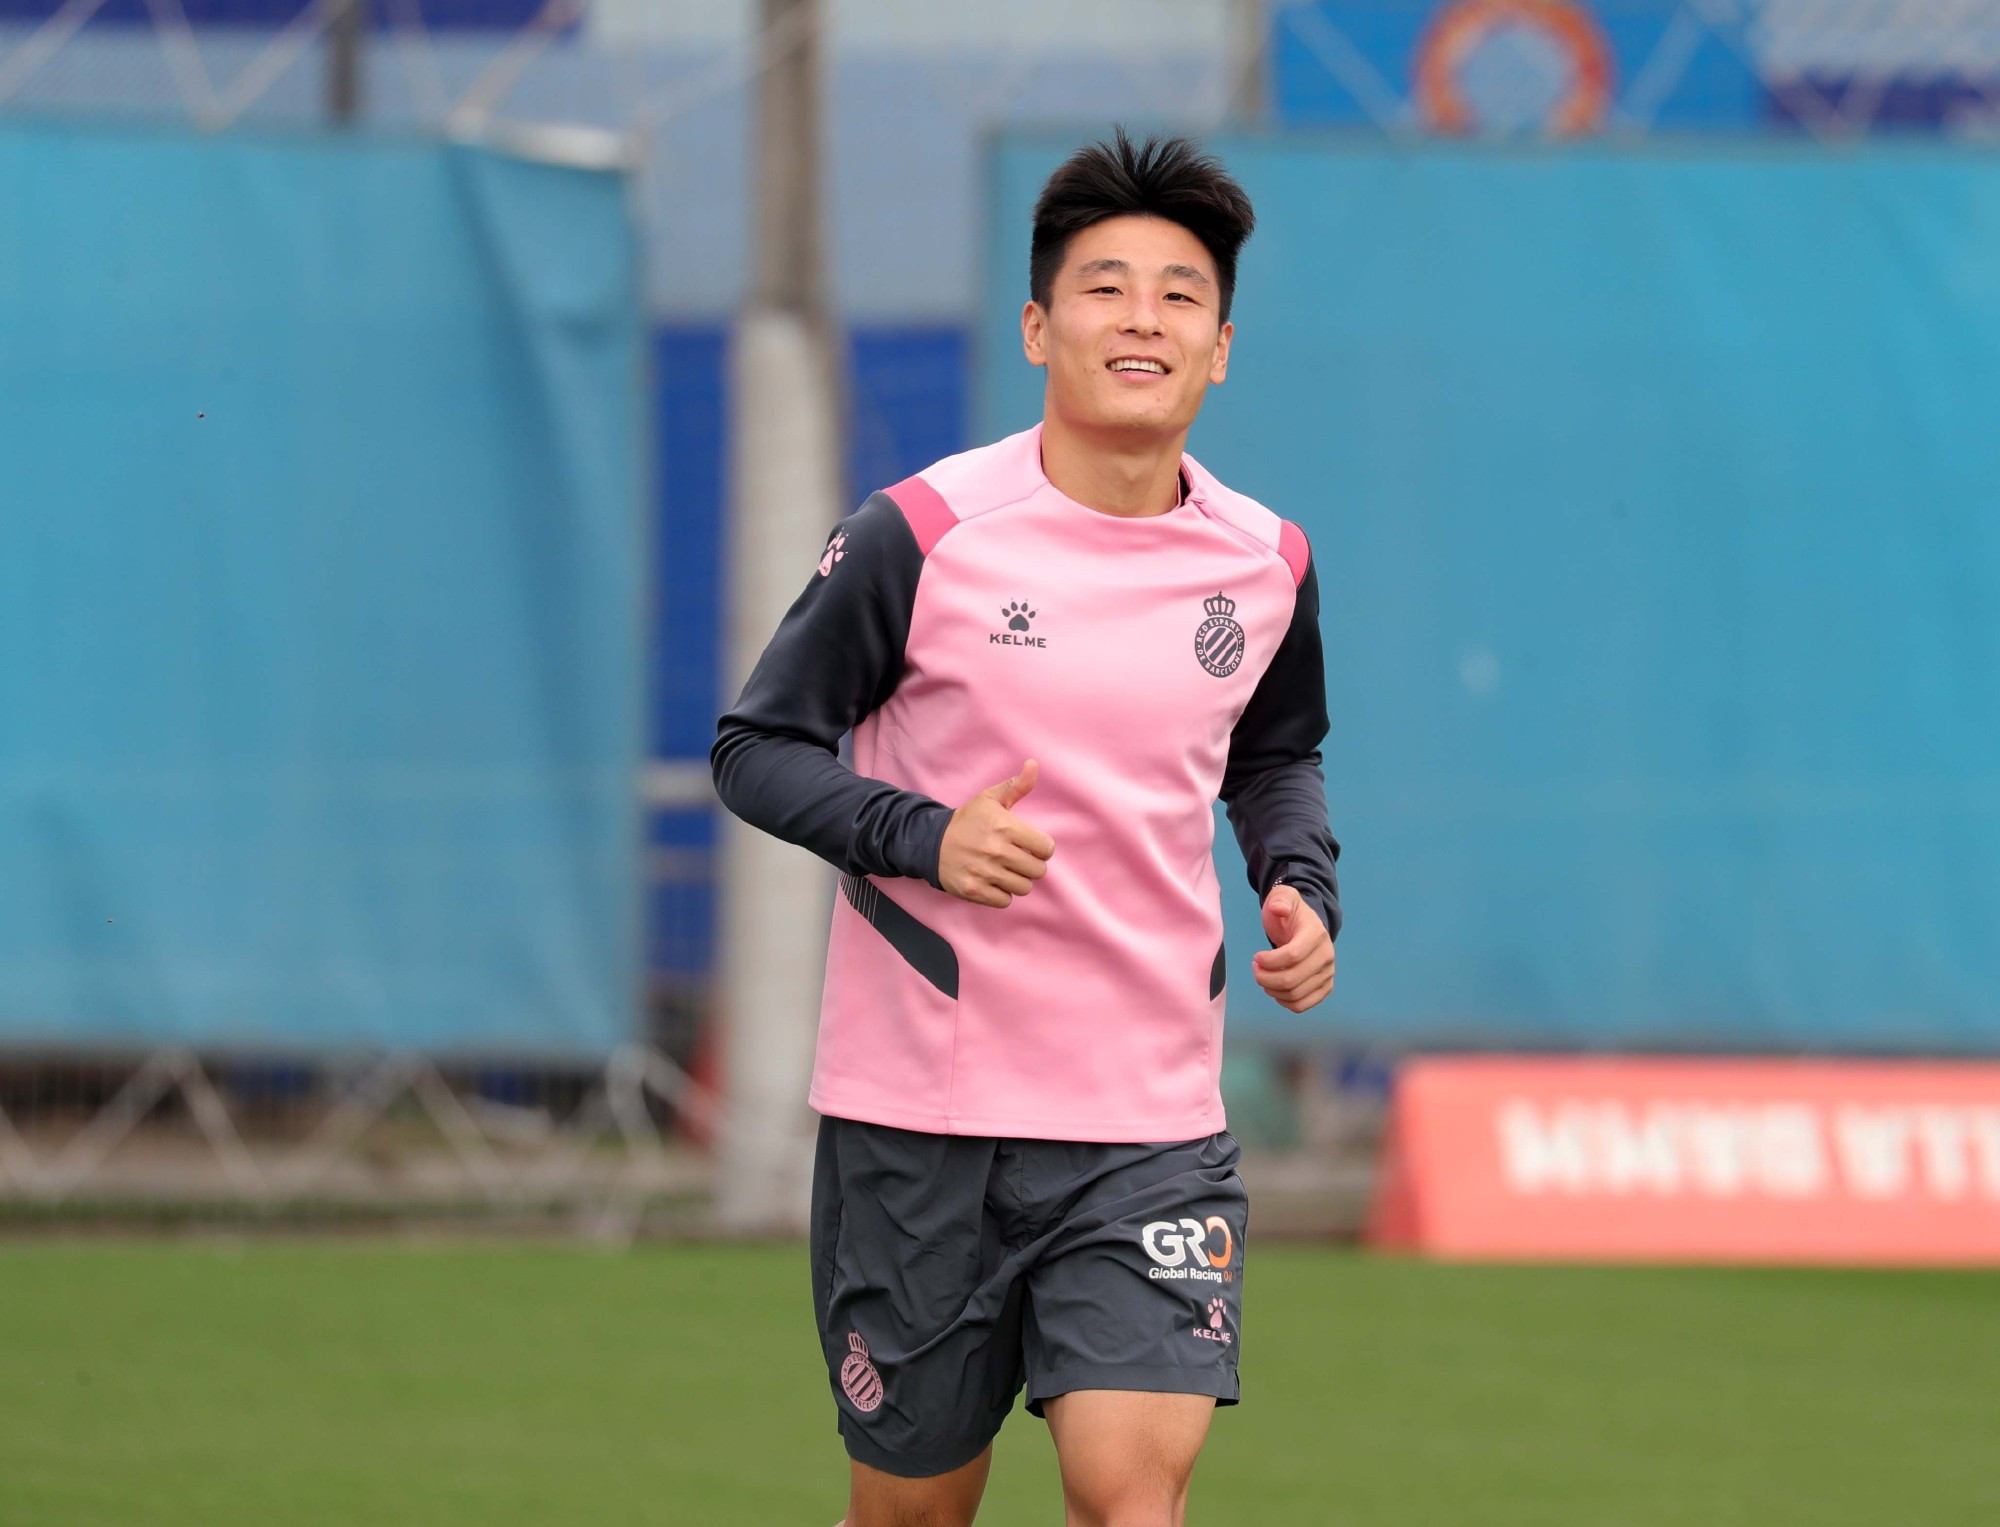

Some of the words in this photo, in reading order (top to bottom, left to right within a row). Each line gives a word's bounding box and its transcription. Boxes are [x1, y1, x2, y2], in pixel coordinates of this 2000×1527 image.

[989, 633, 1047, 649] KELME
[1196, 625, 1208, 643] RCD
[1208, 618, 1243, 645] ESPANYOL
[1197, 649, 1206, 662] DE
[1205, 650, 1243, 676] BARCELONA
[1142, 1215, 1232, 1269] GRO
[1149, 1267, 1188, 1280] Global
[1190, 1267, 1222, 1283] Racing
